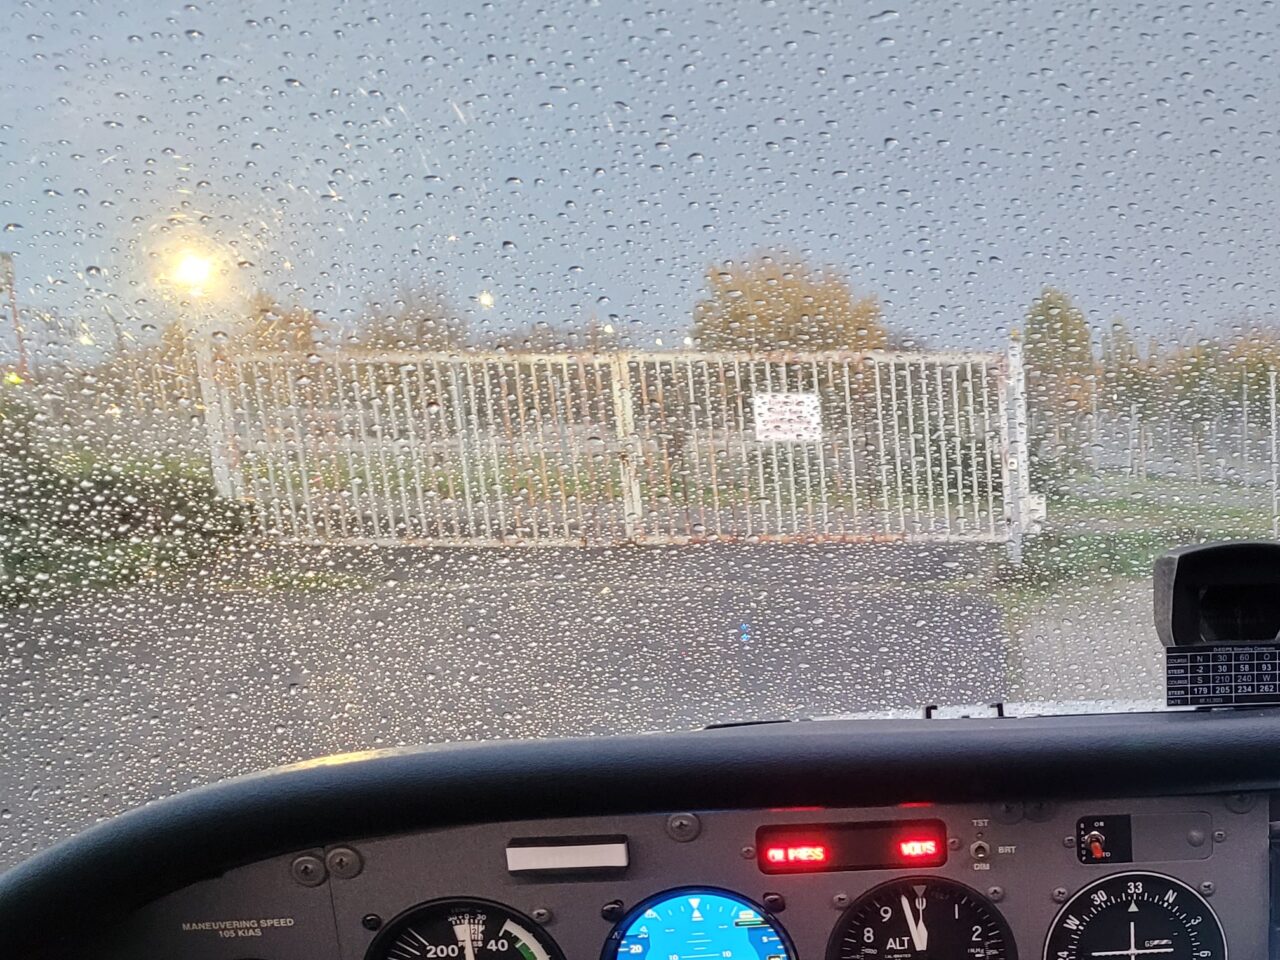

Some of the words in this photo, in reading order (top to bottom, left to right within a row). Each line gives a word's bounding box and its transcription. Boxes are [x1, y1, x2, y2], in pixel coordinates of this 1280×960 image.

[1128, 882, 1143, 893] 33
[1091, 890, 1107, 905] 30
[182, 921, 258, 931] MANEUVERING
[260, 918, 294, 927] SPEED
[219, 930, 235, 938] 105
[238, 928, 262, 937] KIAS
[487, 940, 508, 951] 40
[886, 937, 910, 950] ALT
[426, 945, 458, 958] 200
